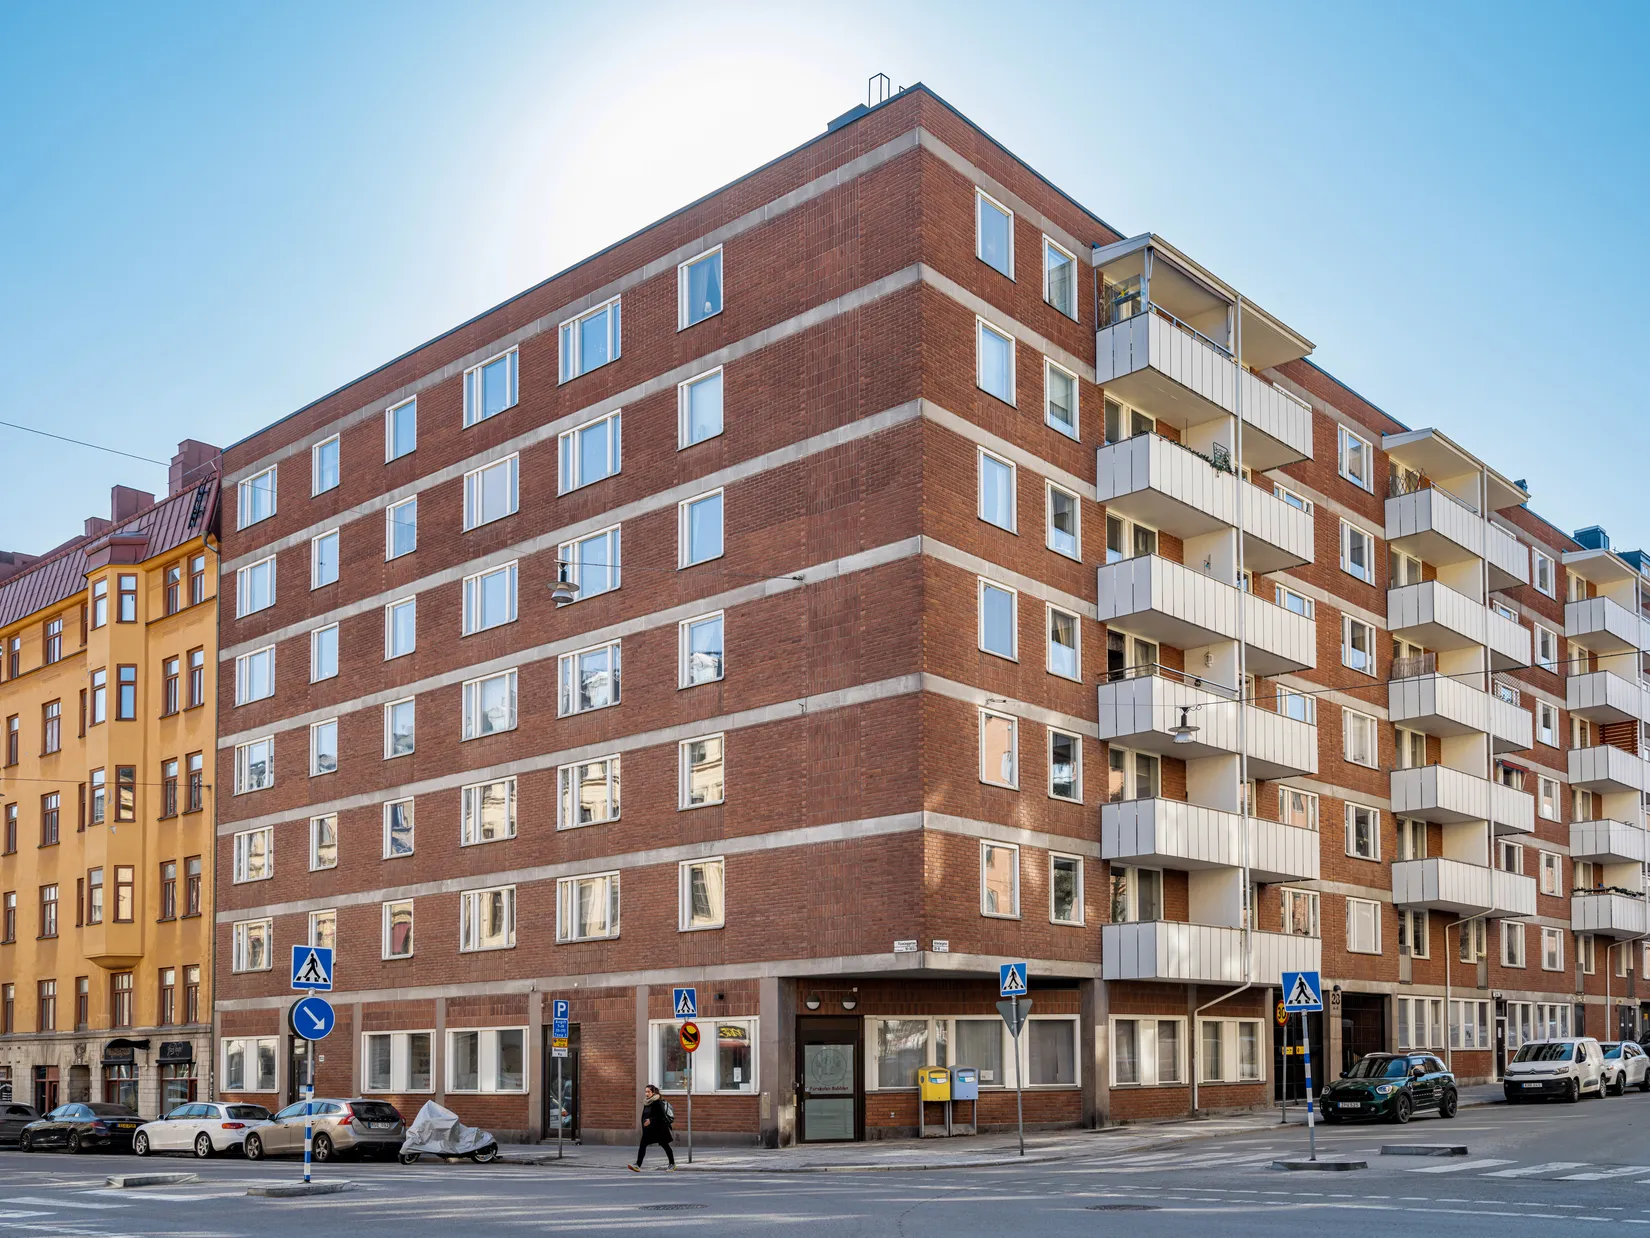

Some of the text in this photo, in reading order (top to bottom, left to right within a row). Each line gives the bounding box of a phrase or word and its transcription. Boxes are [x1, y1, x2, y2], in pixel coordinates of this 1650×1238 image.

[1331, 993, 1340, 1005] 28
[558, 1002, 566, 1017] P
[1278, 1007, 1286, 1019] 30
